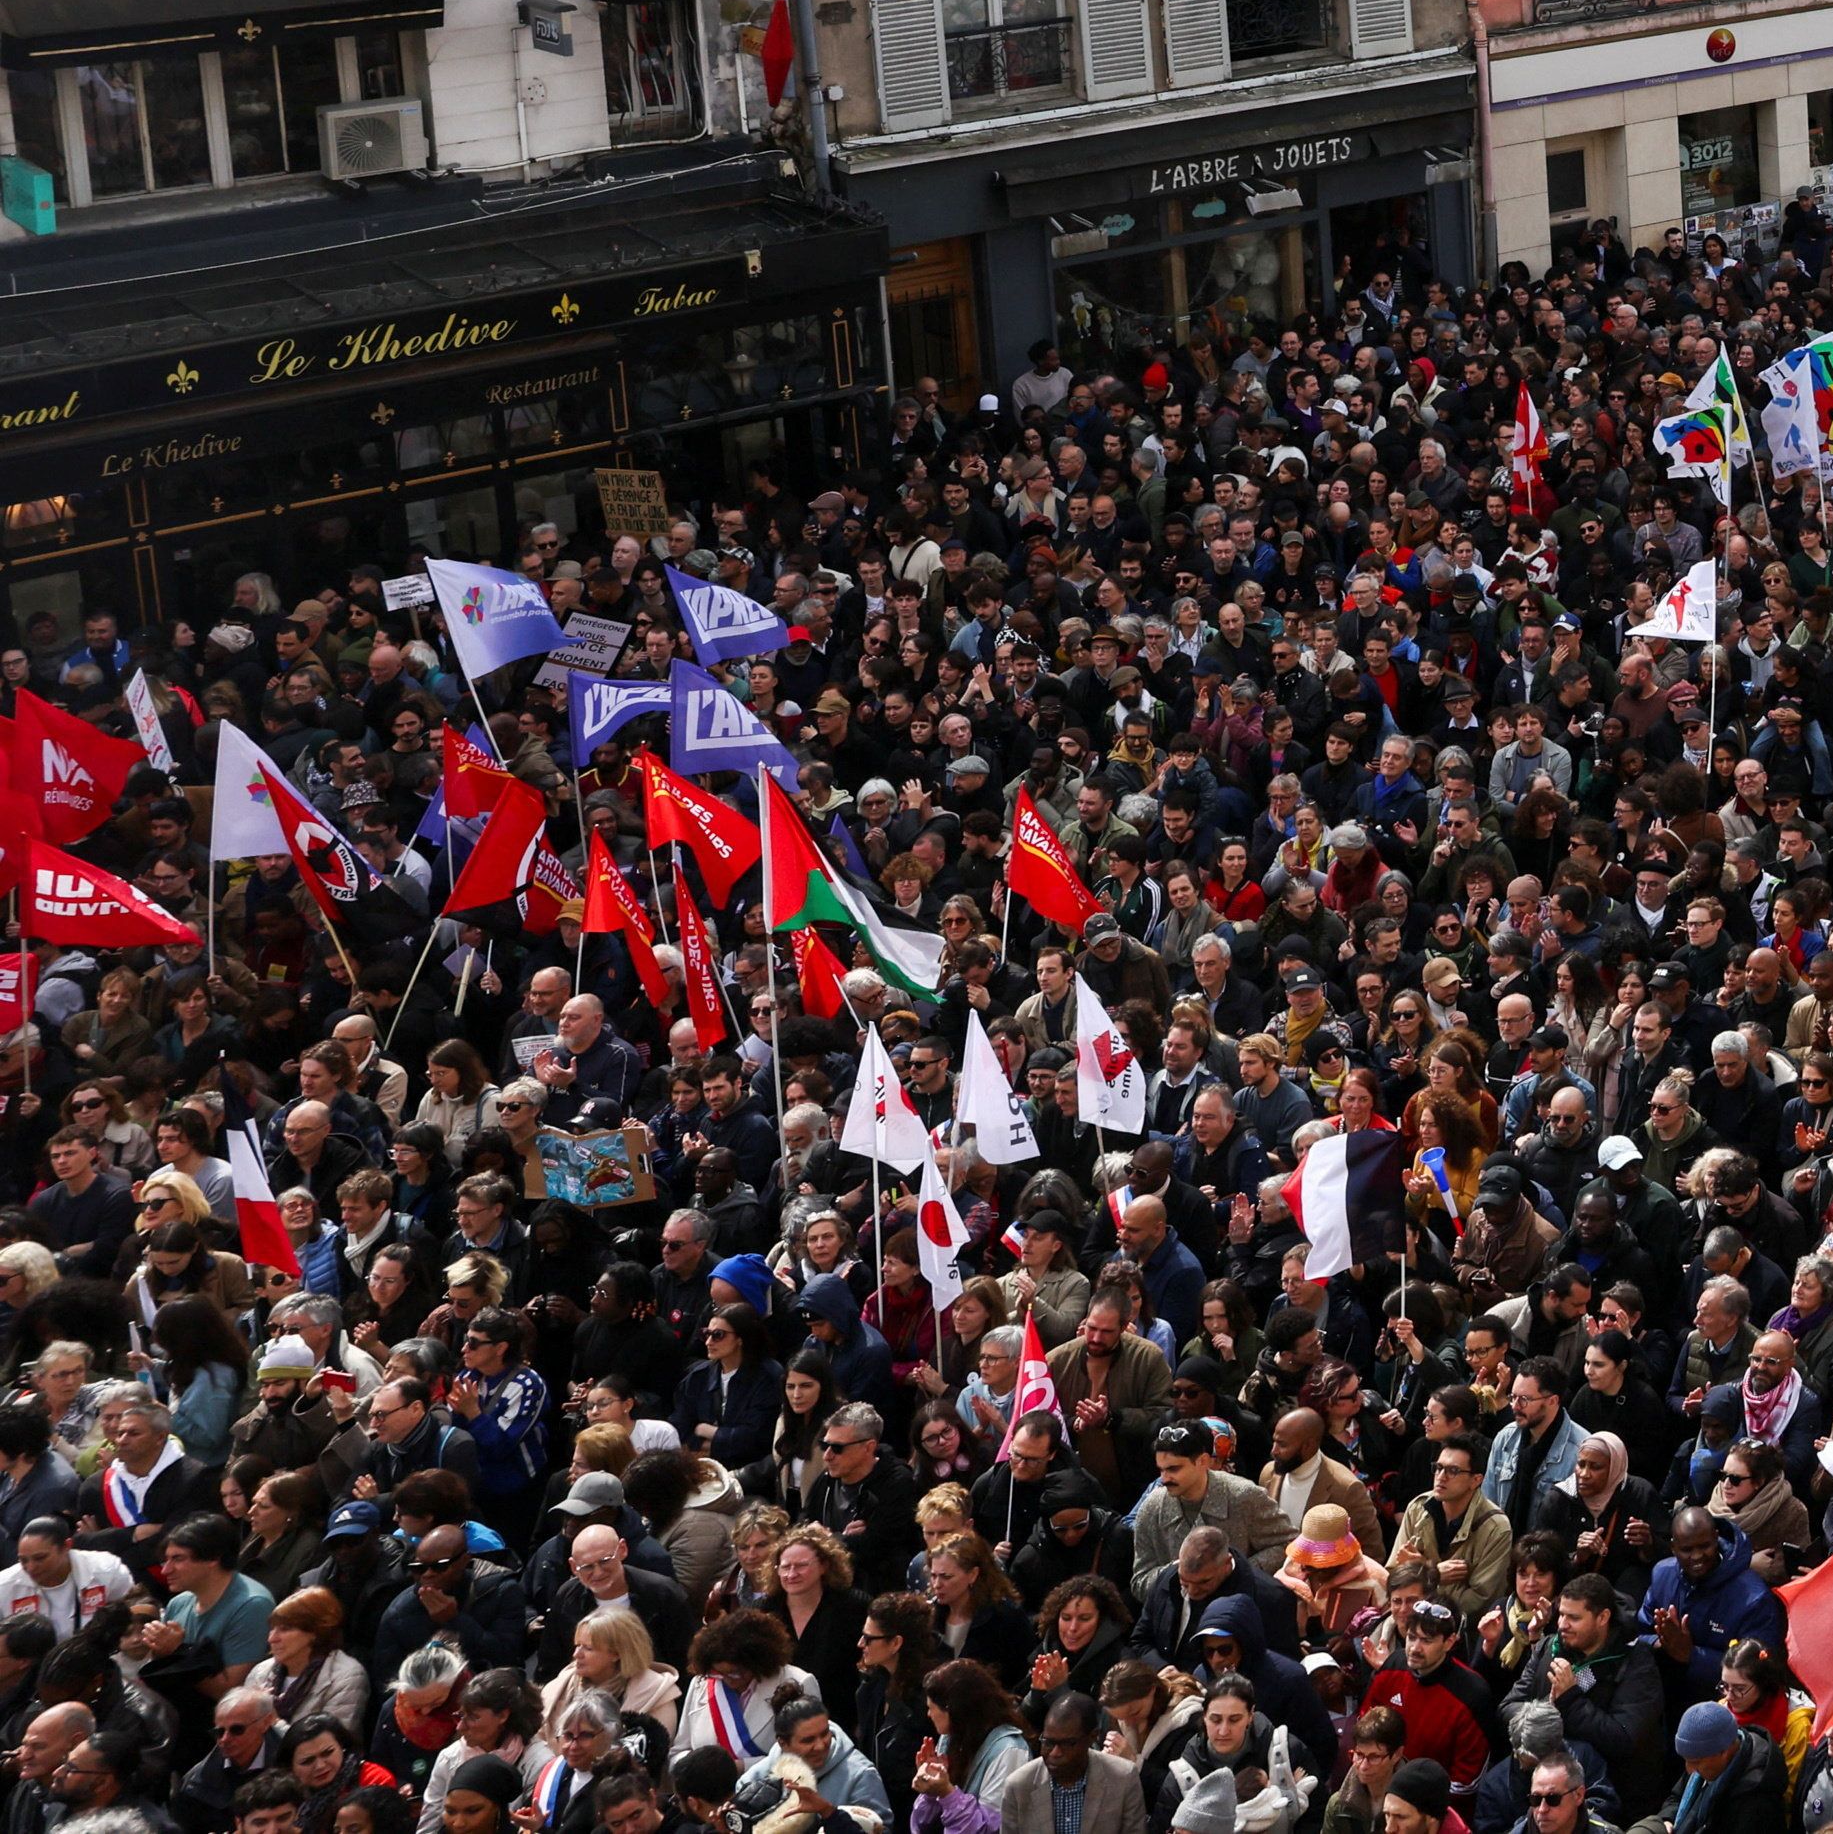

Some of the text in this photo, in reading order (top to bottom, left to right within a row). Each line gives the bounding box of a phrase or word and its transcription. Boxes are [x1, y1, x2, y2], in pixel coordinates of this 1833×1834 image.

[1151, 154, 1240, 194] L'ARBRE
[1273, 137, 1352, 171] JOUETS
[1691, 141, 1733, 163] 3012
[634, 287, 720, 315] Tabac
[249, 315, 517, 384] Le Khedive
[486, 366, 600, 405] Restaurant
[101, 432, 241, 478] Le Khedive
[570, 616, 627, 634] PROTÉGEONS
[553, 651, 606, 669] MOMENT
[588, 642, 609, 655] CE
